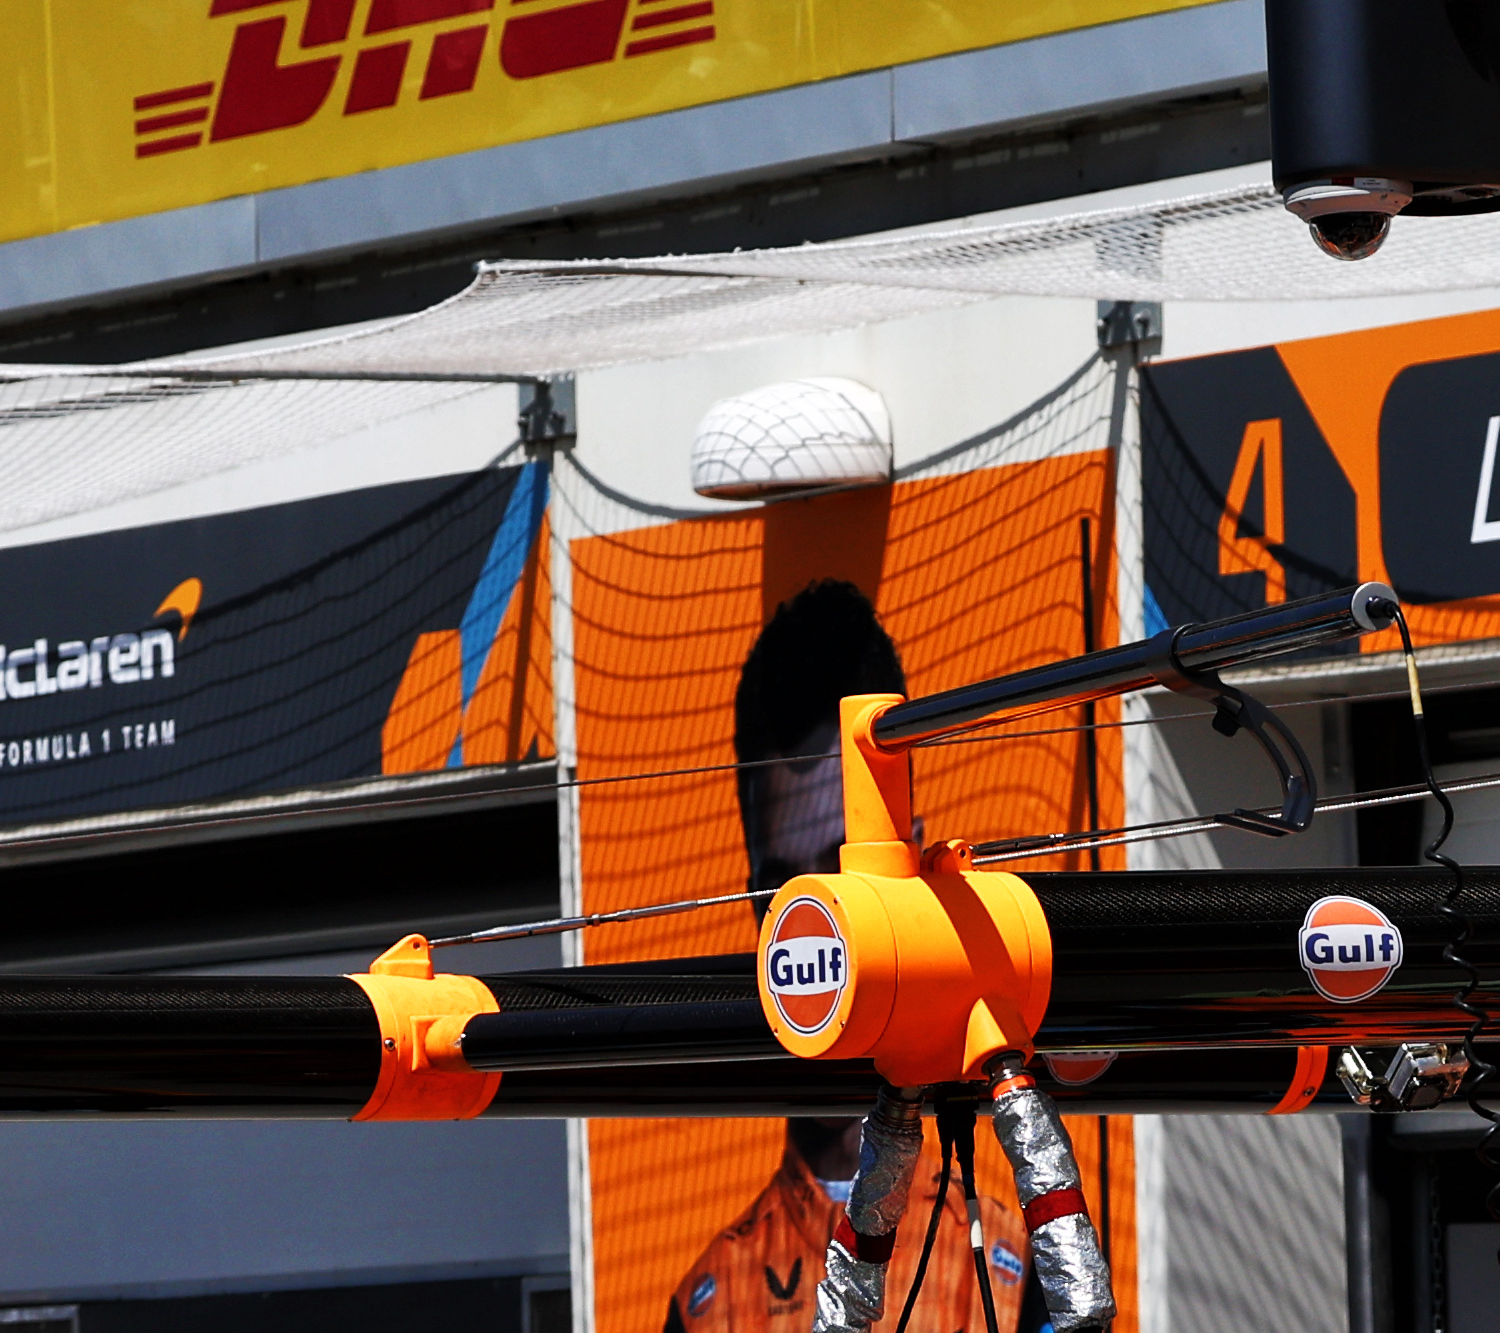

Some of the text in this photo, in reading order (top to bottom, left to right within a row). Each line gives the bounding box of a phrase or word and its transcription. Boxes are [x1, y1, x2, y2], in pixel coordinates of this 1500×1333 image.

[1217, 418, 1286, 605] 4
[102, 730, 111, 752] 1
[122, 719, 177, 747] TEAM
[1305, 932, 1396, 964] Gulf
[769, 947, 844, 986] Gulf
